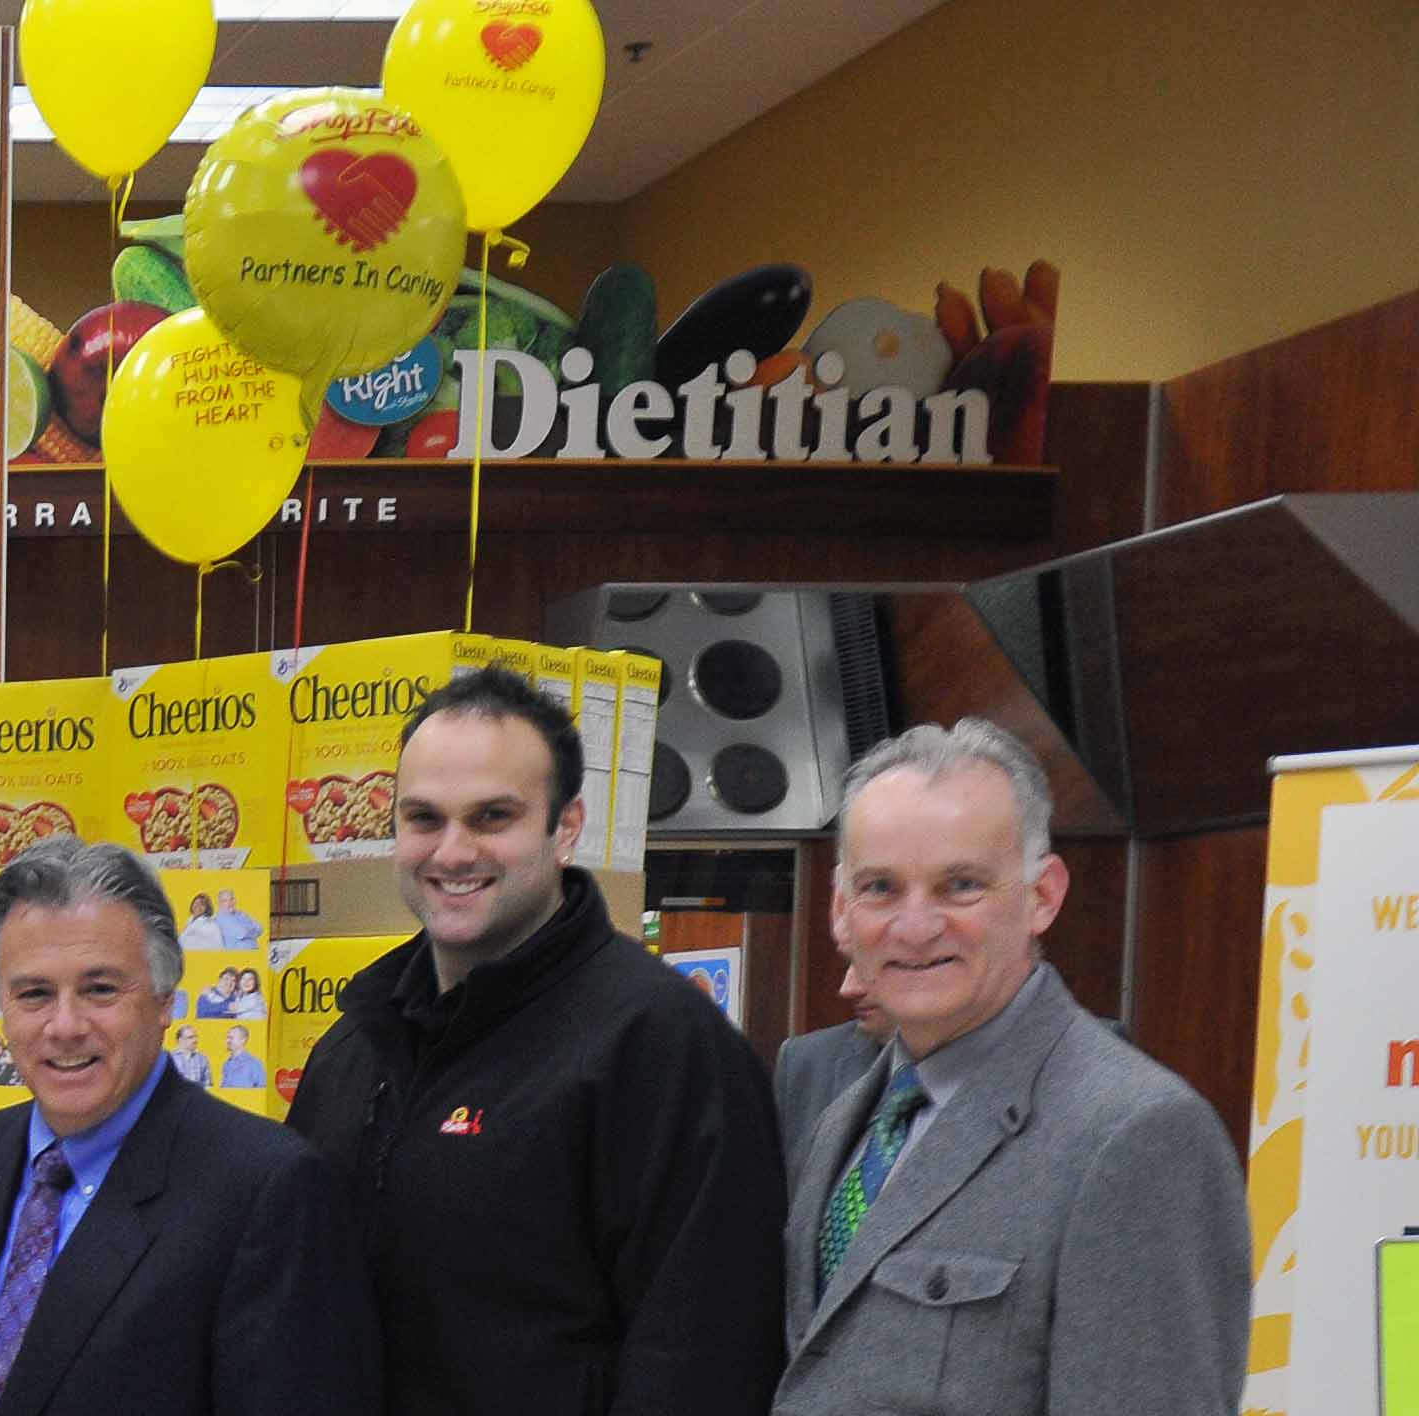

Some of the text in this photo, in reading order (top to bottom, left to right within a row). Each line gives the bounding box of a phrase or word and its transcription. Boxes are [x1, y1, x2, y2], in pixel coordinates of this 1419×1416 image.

[241, 256, 444, 305] Partners In Caring
[175, 379, 276, 409] FROM THE
[195, 403, 263, 427] HEART
[448, 348, 995, 467] Dietitian
[127, 690, 257, 740] Cheerios
[289, 674, 431, 725] Cheerios
[43, 772, 84, 787] OATS
